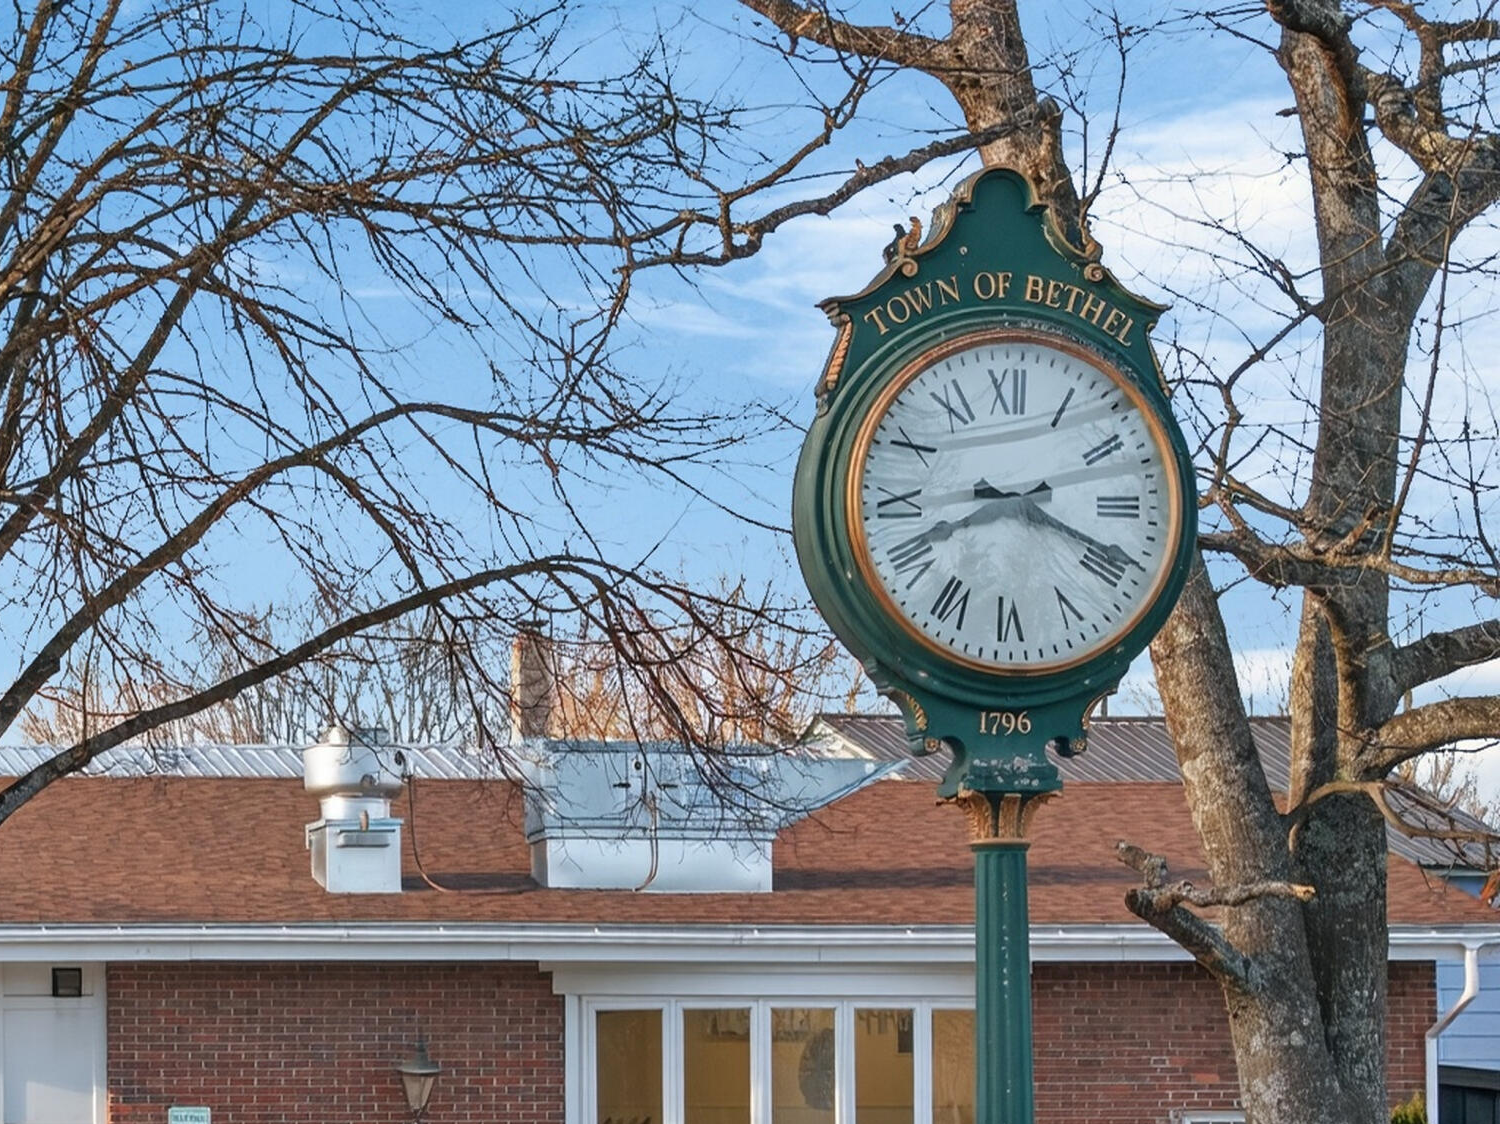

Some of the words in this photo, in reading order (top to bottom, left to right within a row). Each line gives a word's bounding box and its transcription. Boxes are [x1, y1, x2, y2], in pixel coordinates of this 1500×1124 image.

[863, 275, 961, 336] TOWN
[973, 271, 1013, 300] OF
[1024, 274, 1133, 348] BETHEL
[929, 378, 976, 434] XI
[987, 367, 1027, 417] XII
[1050, 386, 1076, 429] I
[889, 424, 938, 469] X
[1081, 432, 1125, 467] II
[876, 486, 923, 519] IX
[1096, 495, 1141, 519] III
[930, 575, 972, 632] VII
[996, 595, 1025, 643] VI
[979, 711, 1033, 737] 1796
